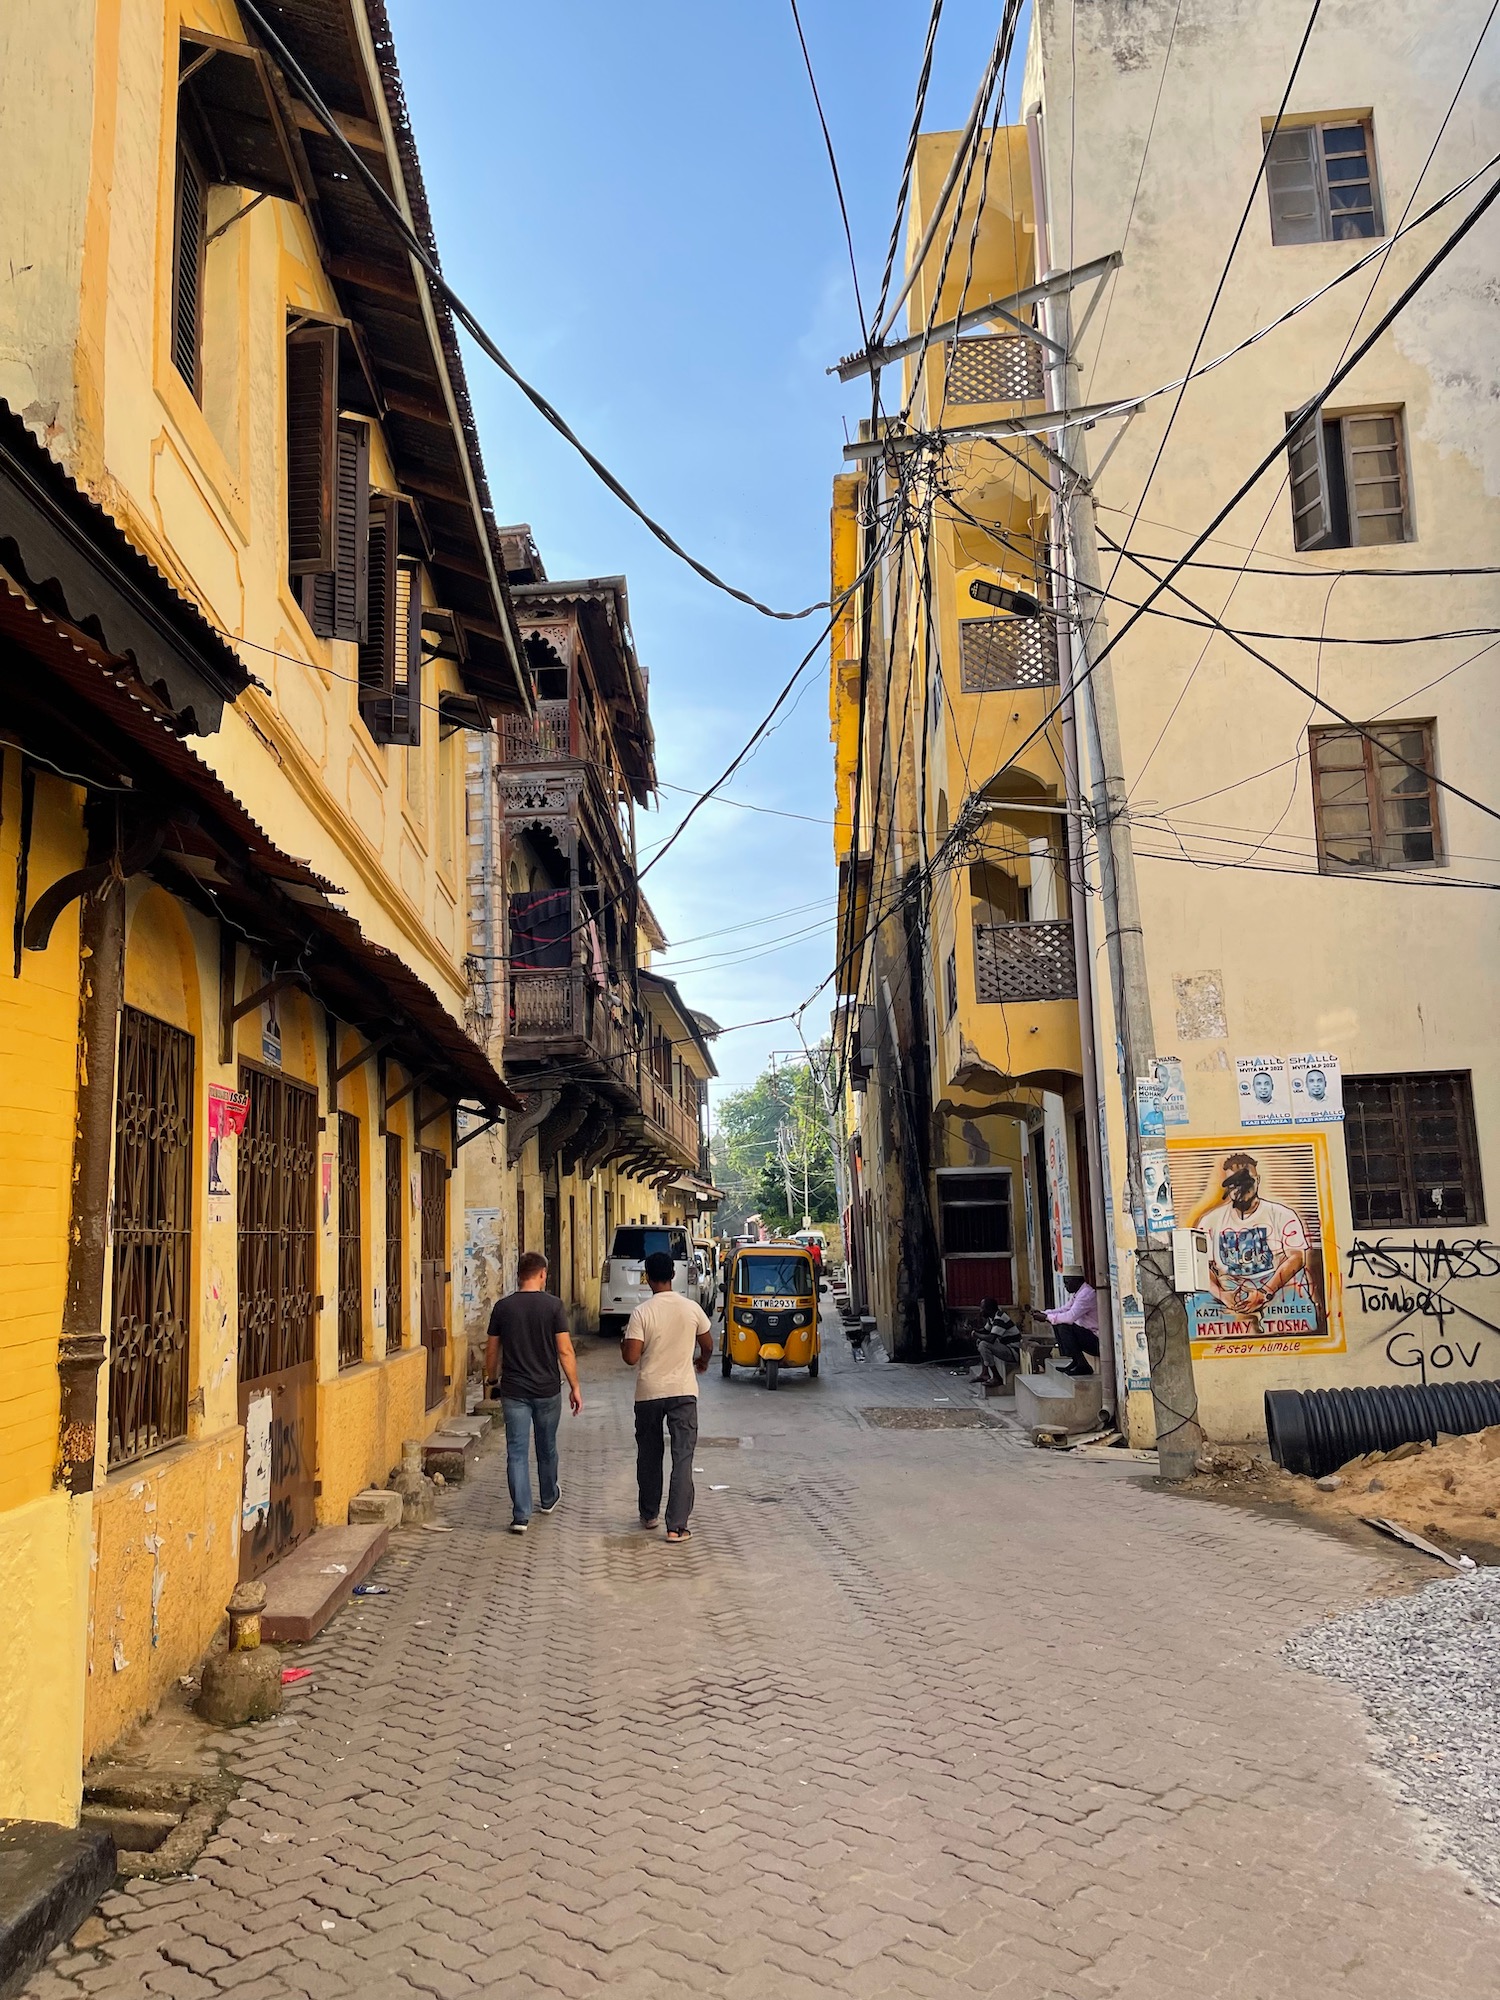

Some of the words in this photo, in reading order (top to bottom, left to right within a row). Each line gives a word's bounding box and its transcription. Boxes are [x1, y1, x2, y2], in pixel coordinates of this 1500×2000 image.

[1237, 1057, 1285, 1067] SHALLO
[1289, 1054, 1338, 1064] SHALLO
[230, 1092, 247, 1106] ISSA
[1196, 1309, 1219, 1317] KAZI
[1267, 1305, 1313, 1315] IENDELEE
[1197, 1321, 1251, 1336] HATIMY
[1263, 1319, 1310, 1333] TOSHA
